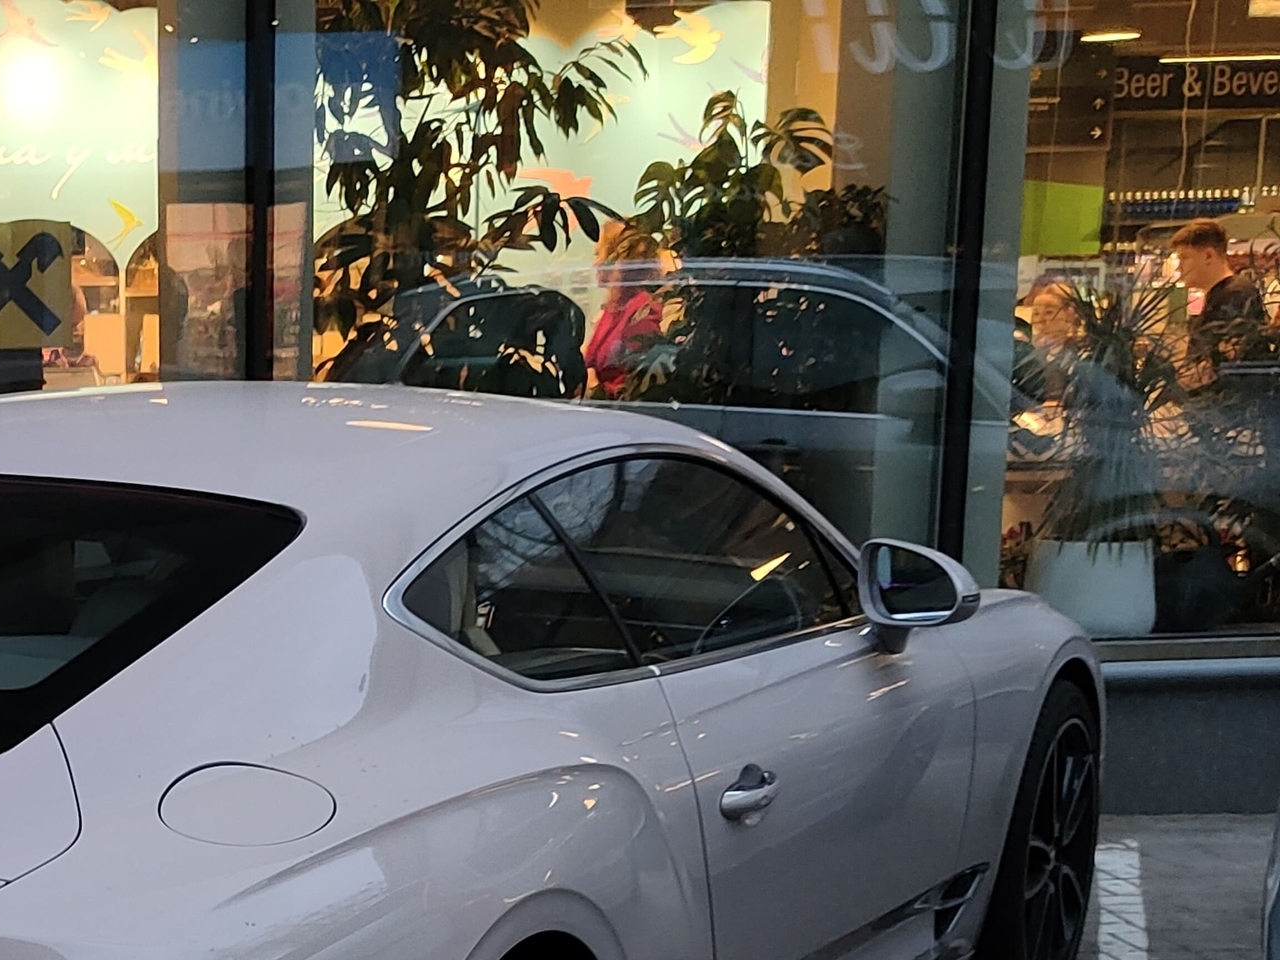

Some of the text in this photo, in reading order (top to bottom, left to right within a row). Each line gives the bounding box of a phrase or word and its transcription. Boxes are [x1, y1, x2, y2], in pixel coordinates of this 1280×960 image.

[1113, 64, 1280, 98] Beer & Beve
[51, 145, 94, 200] у
